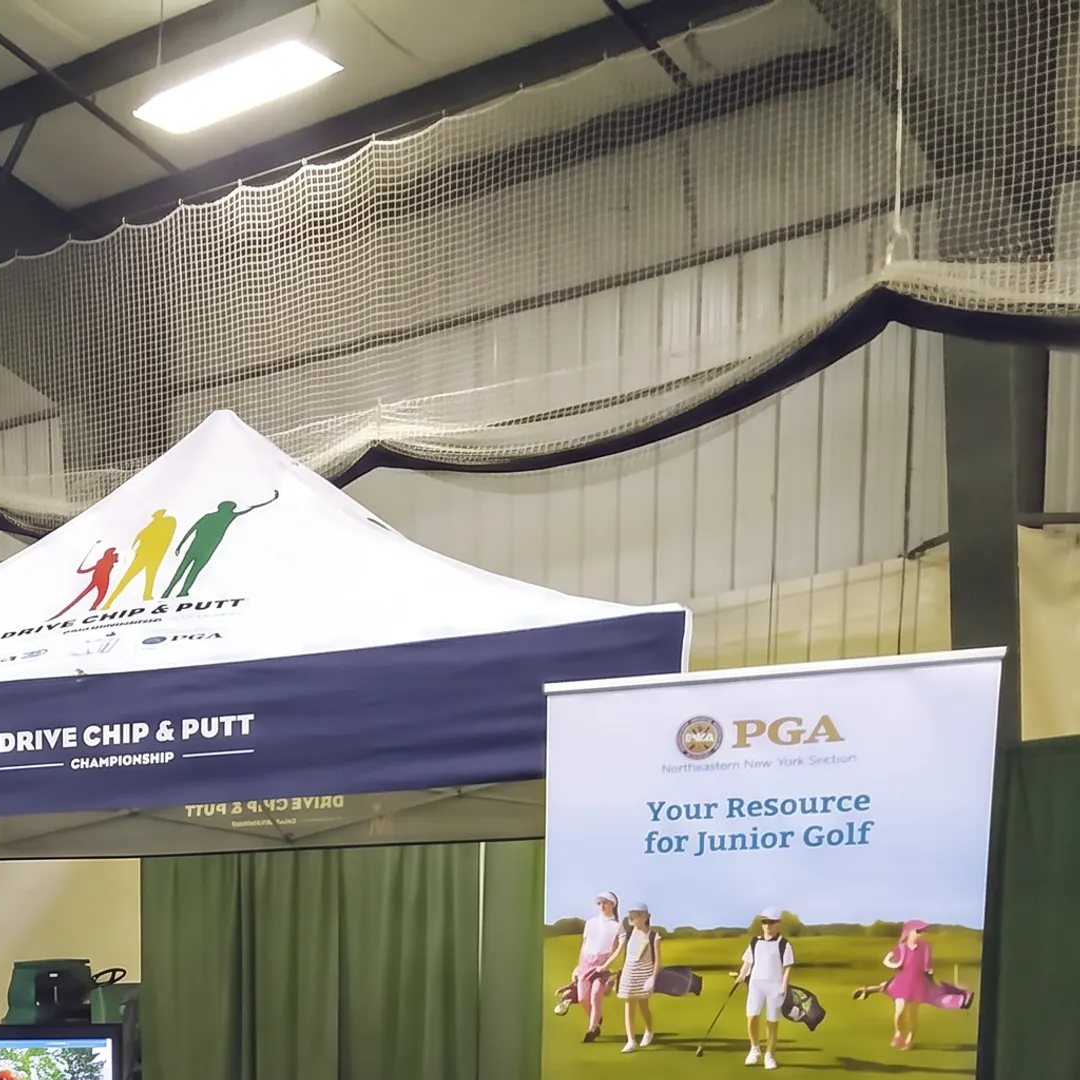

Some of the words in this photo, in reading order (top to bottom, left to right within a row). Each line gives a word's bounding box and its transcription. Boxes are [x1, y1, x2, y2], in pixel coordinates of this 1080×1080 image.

[0, 618, 77, 640] DRIVE
[82, 607, 146, 626] CHIP
[150, 603, 170, 615] &
[175, 598, 246, 613] PUTT
[83, 722, 150, 747] CHIP
[155, 720, 175, 742] &
[182, 714, 255, 740] PUTT
[731, 714, 846, 749] PGA
[70, 751, 175, 770] CHAMPIONSHIP
[777, 755, 804, 767] York
[646, 800, 719, 822] Your
[725, 793, 872, 819] Resource
[644, 830, 690, 854] for
[694, 826, 795, 857] Junior
[802, 821, 875, 847] Golf
